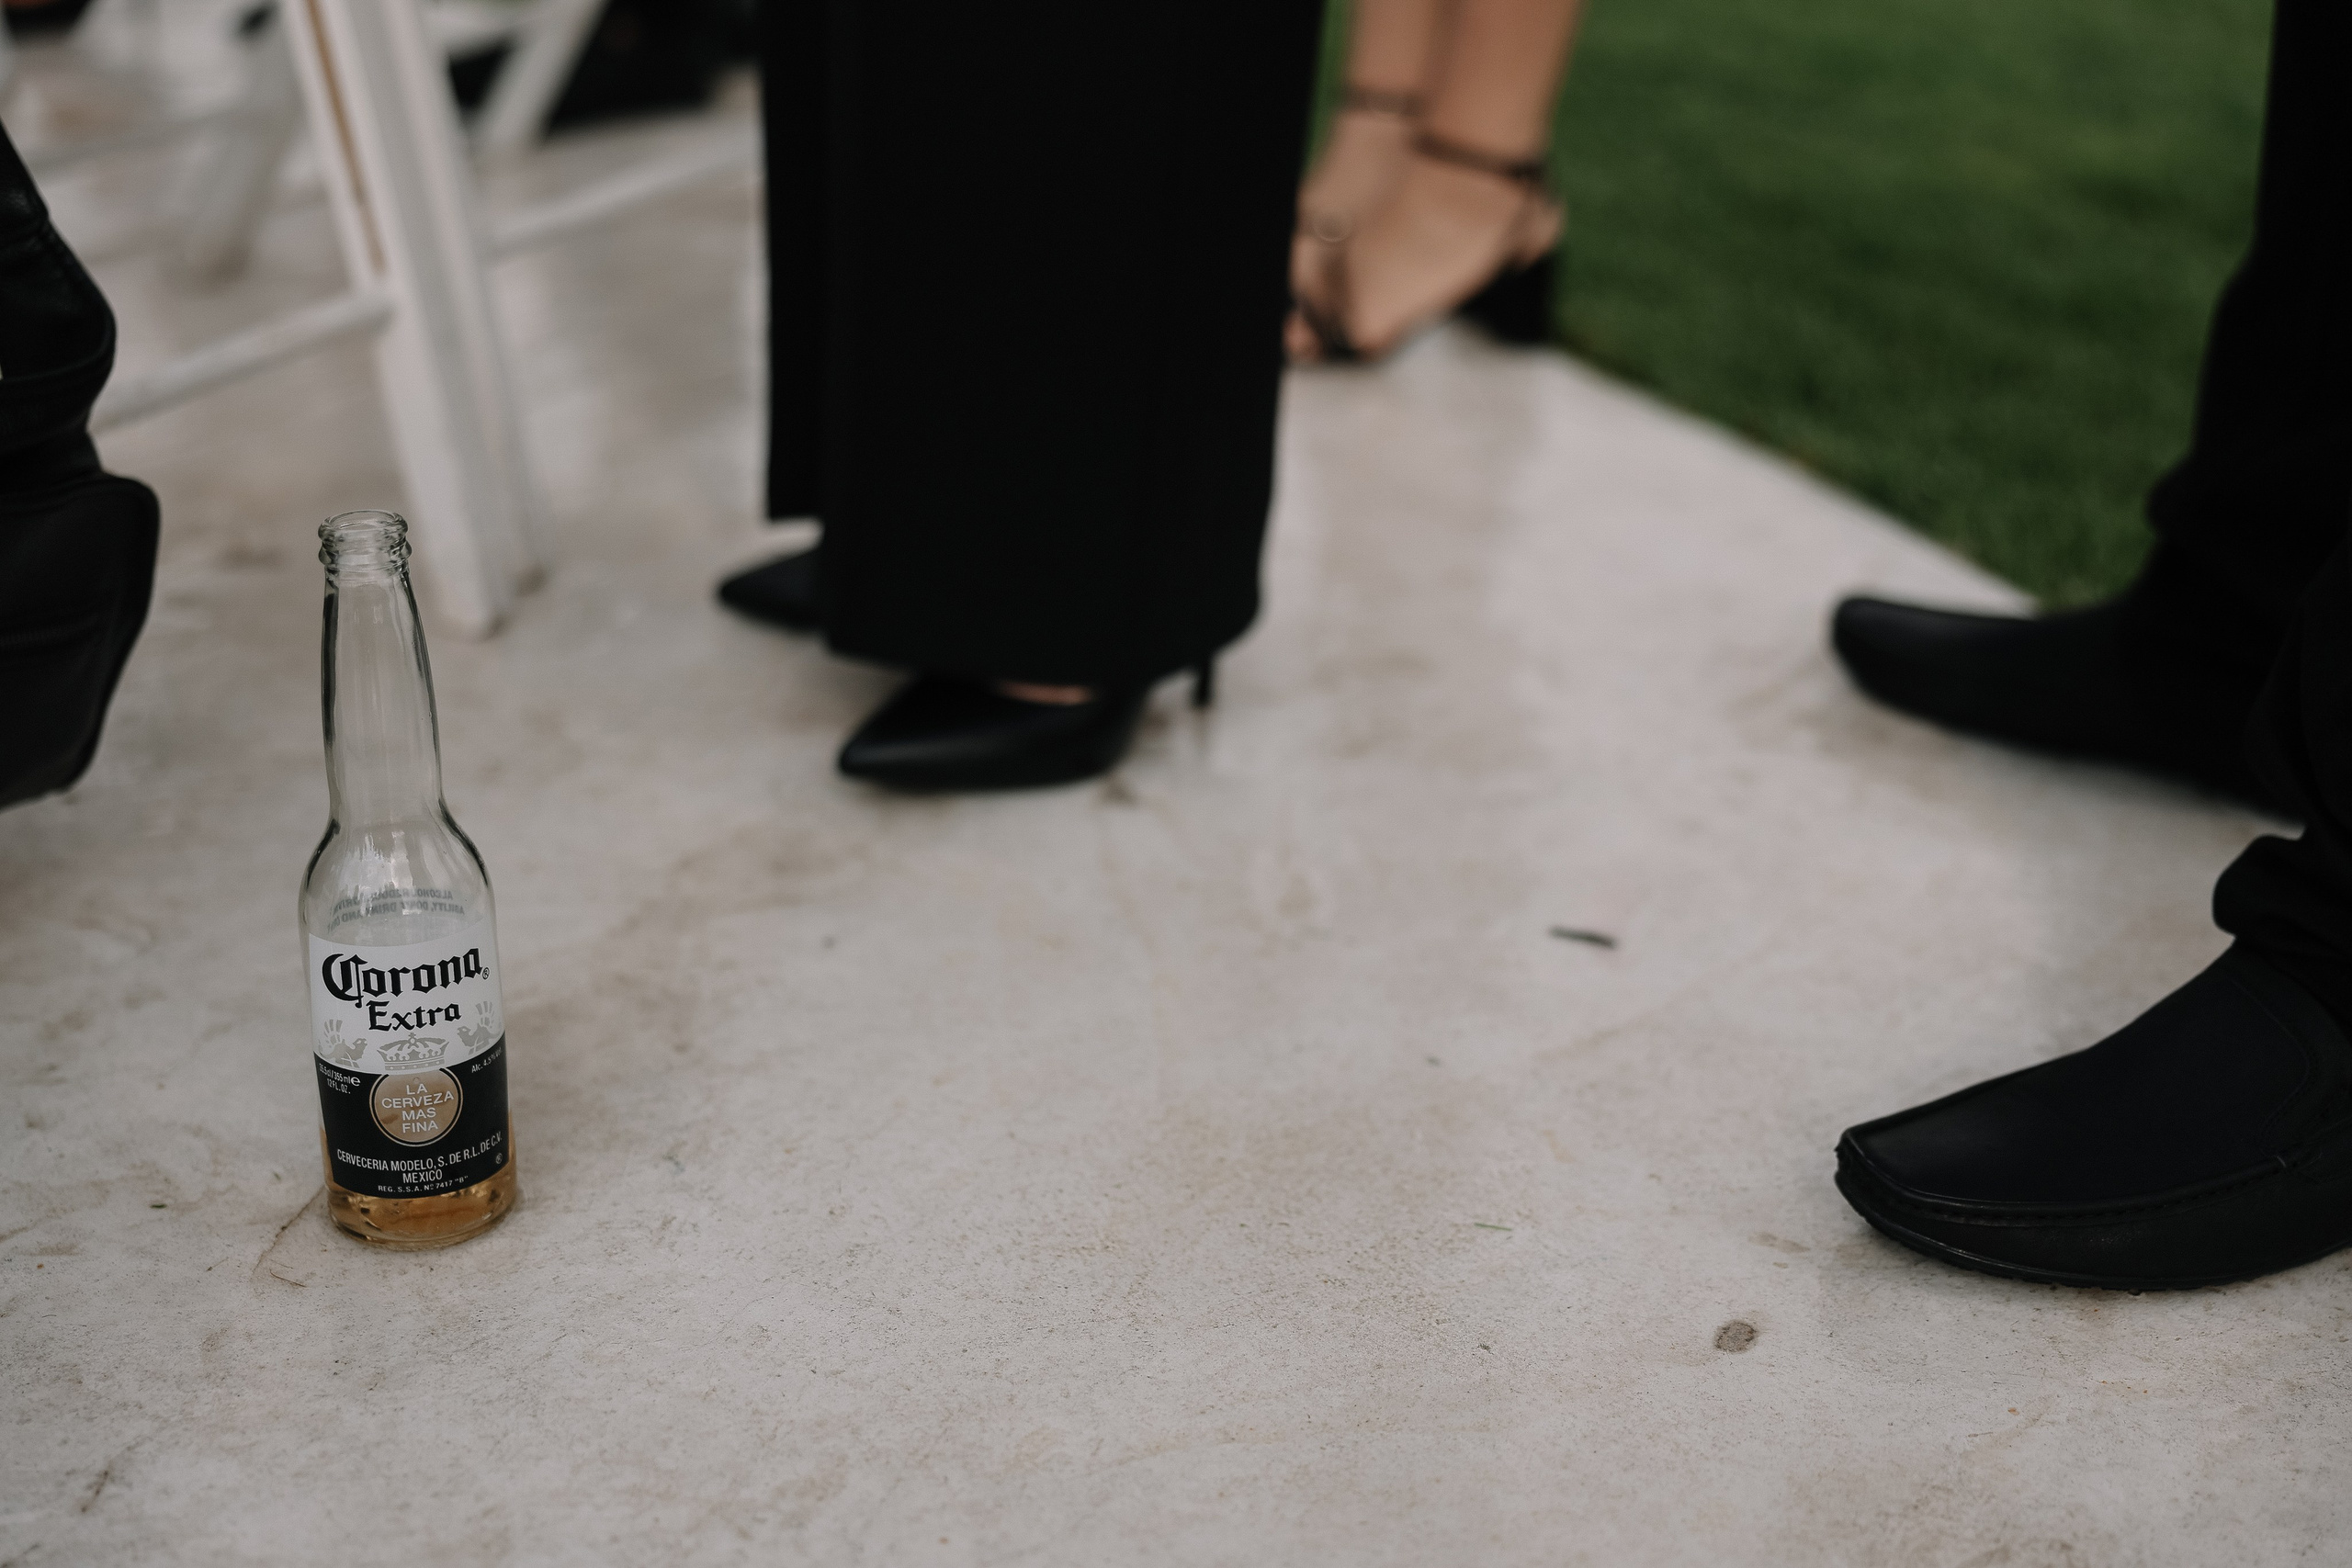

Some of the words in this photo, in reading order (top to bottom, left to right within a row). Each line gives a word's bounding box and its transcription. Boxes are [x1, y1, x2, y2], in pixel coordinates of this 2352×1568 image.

[322, 947, 482, 1009] Corona
[366, 1000, 462, 1032] Extra
[406, 1084, 428, 1095] LA
[381, 1090, 455, 1109] CERVEZA
[401, 1108, 436, 1121] MAS
[401, 1121, 439, 1134] FINA
[336, 1148, 390, 1171] CERVECERIA
[390, 1157, 437, 1172] MODELO,
[437, 1156, 448, 1168] S.
[449, 1151, 462, 1165] DE
[463, 1146, 481, 1160] R.L.
[481, 1139, 491, 1154] DE
[402, 1168, 443, 1184] MEXICO
[435, 1179, 453, 1190] 7417
